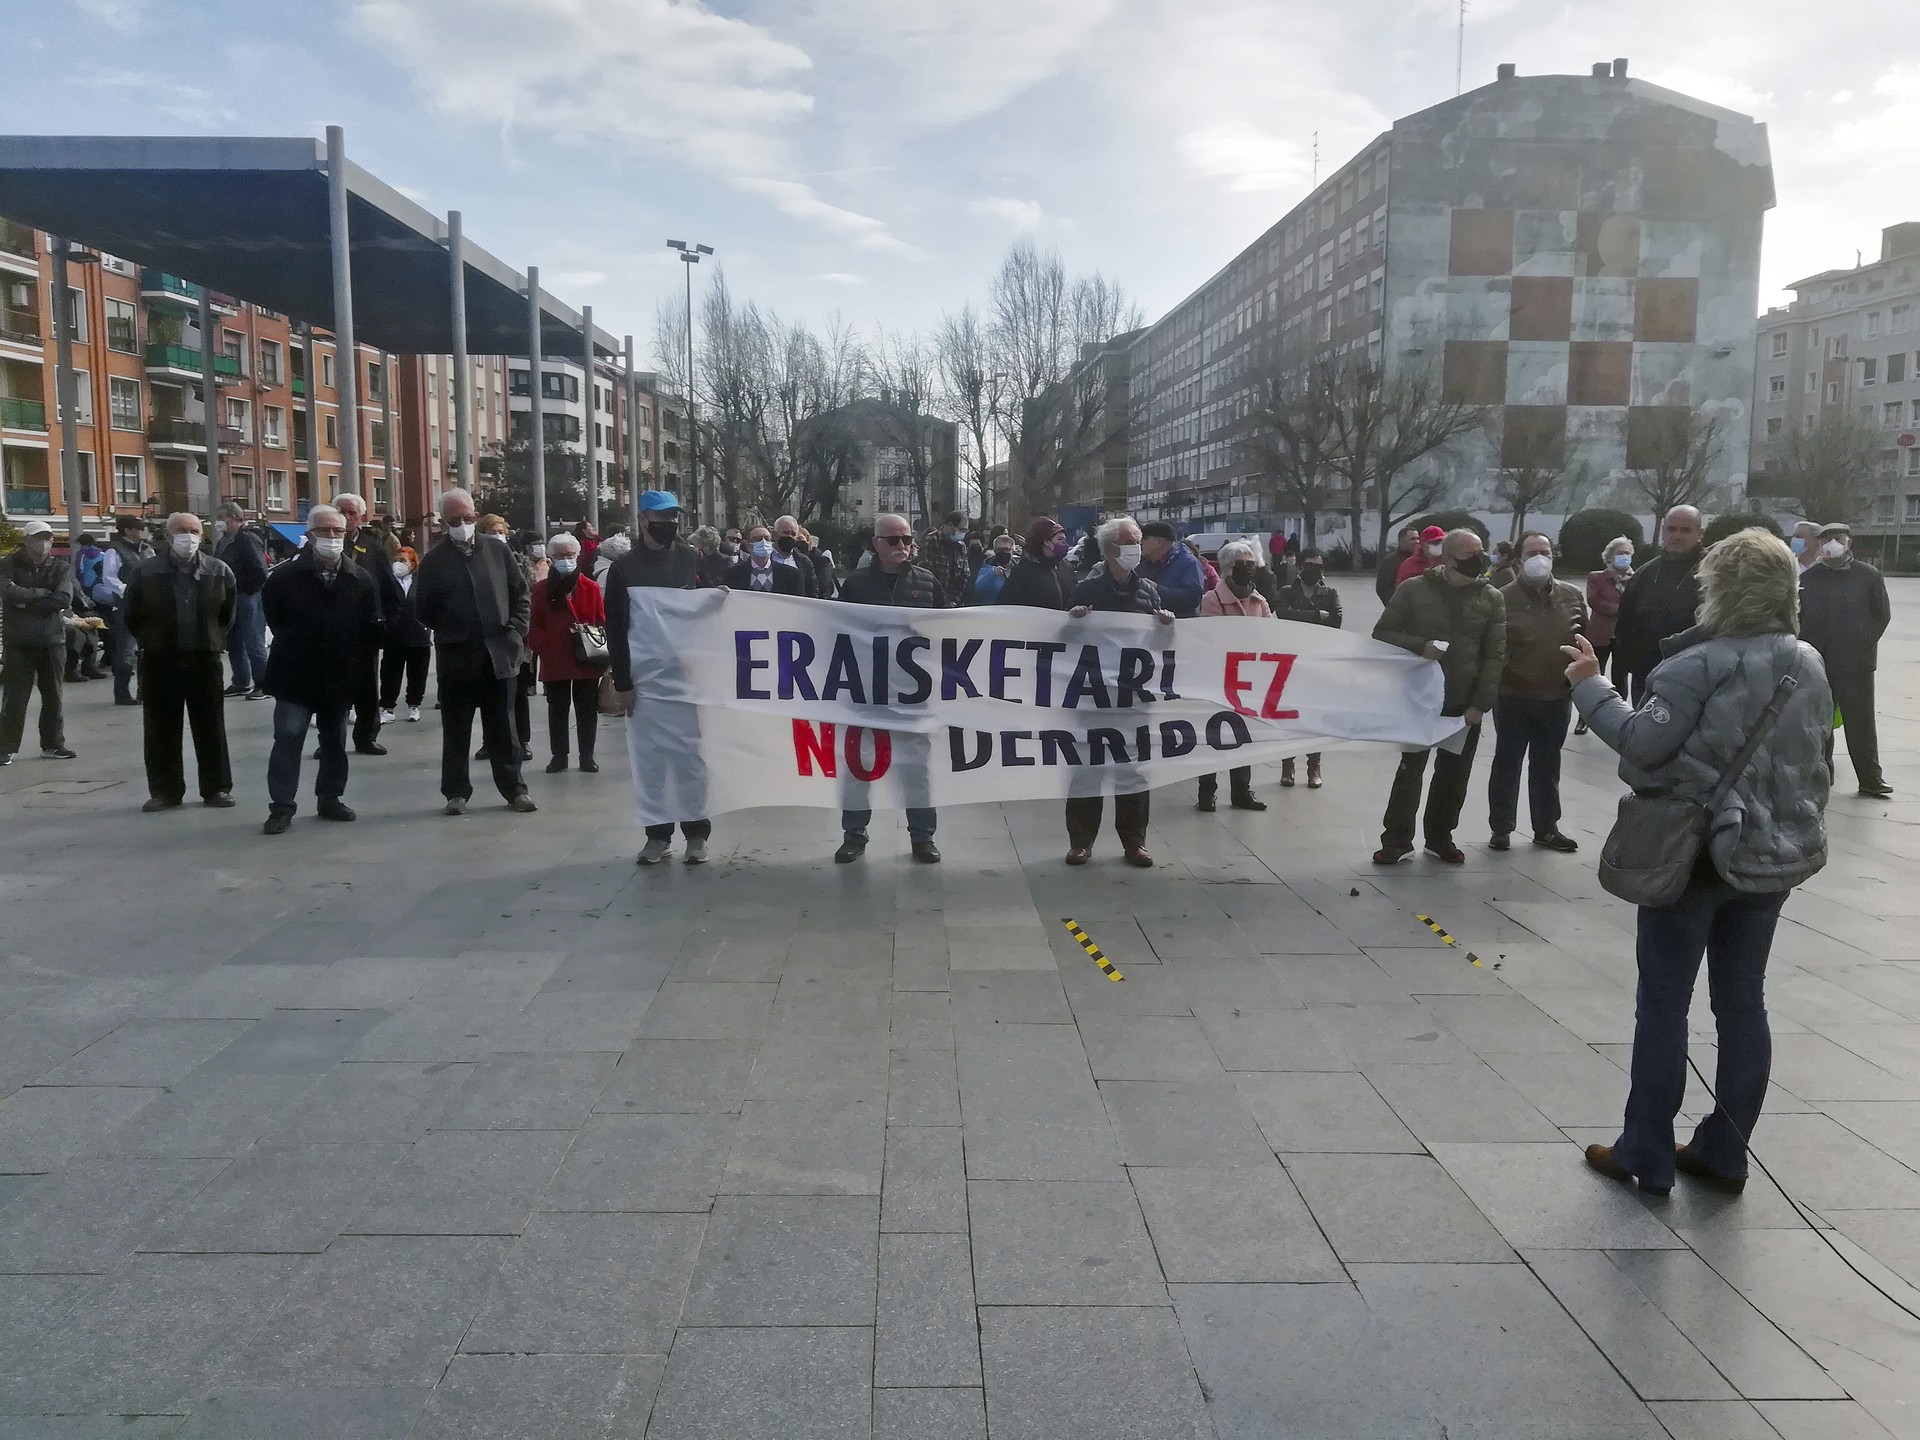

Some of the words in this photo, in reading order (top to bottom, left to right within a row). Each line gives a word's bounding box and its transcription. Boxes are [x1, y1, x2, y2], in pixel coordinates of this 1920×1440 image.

[735, 630, 1181, 708] ERAISKETARI
[1224, 651, 1300, 719] EZ
[791, 718, 892, 782] NO
